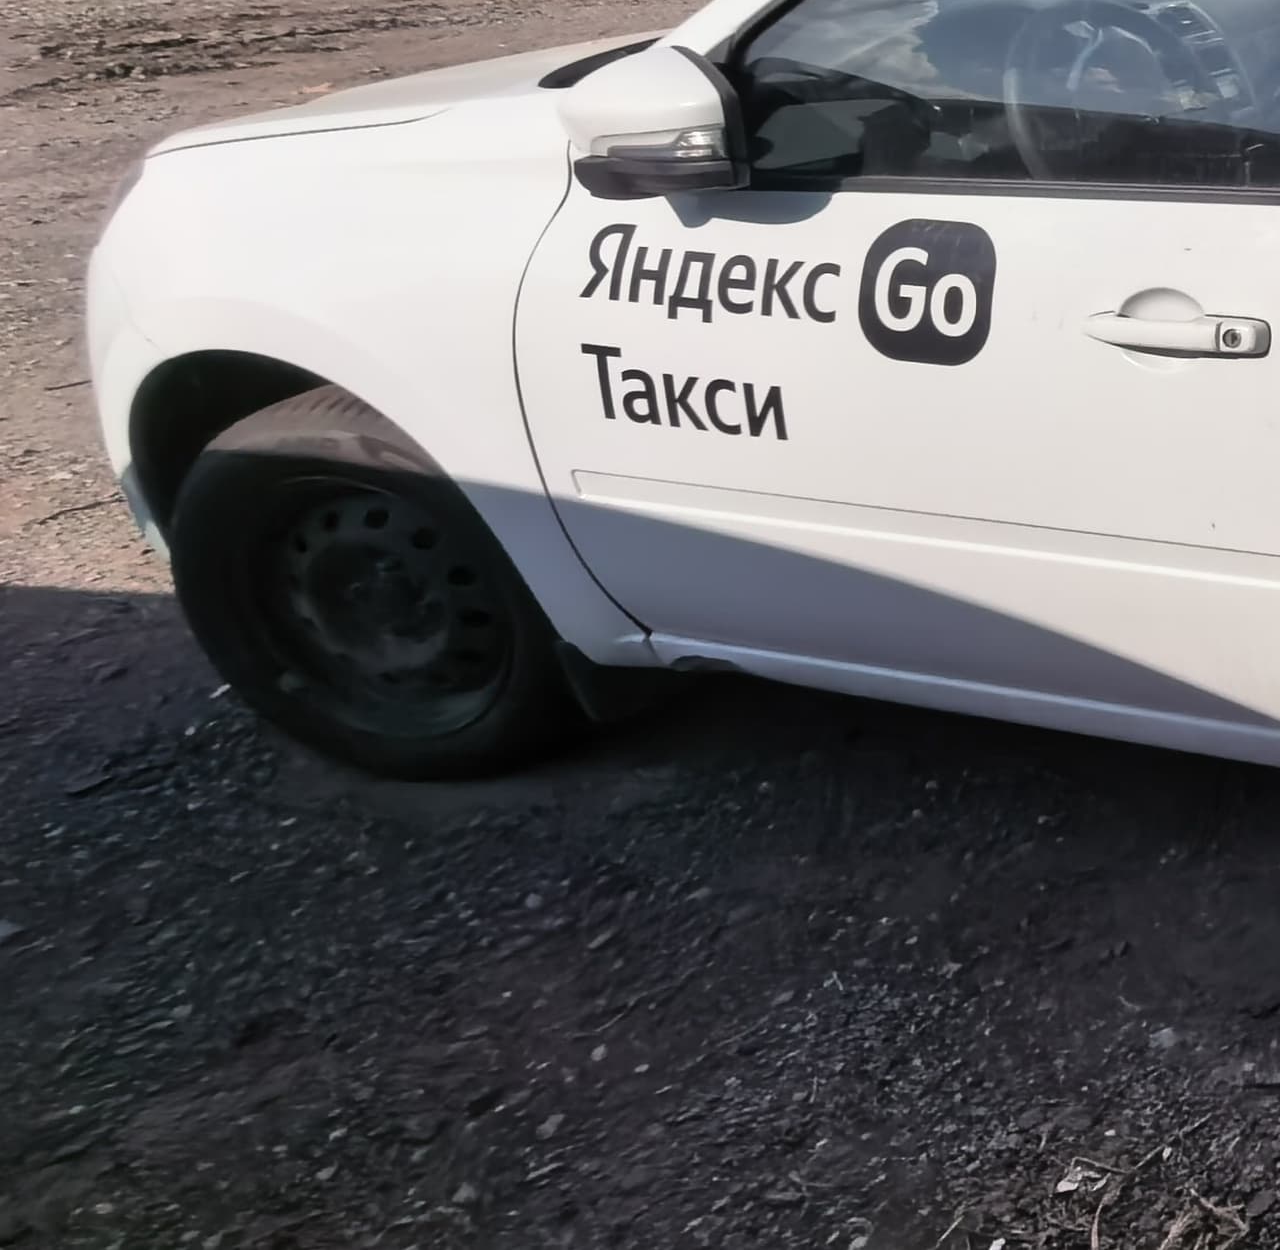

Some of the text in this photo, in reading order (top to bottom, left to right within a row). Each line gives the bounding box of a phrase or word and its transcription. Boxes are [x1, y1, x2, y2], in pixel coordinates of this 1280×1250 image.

[579, 223, 977, 337] Яндекс Go
[580, 343, 788, 441] Такси
